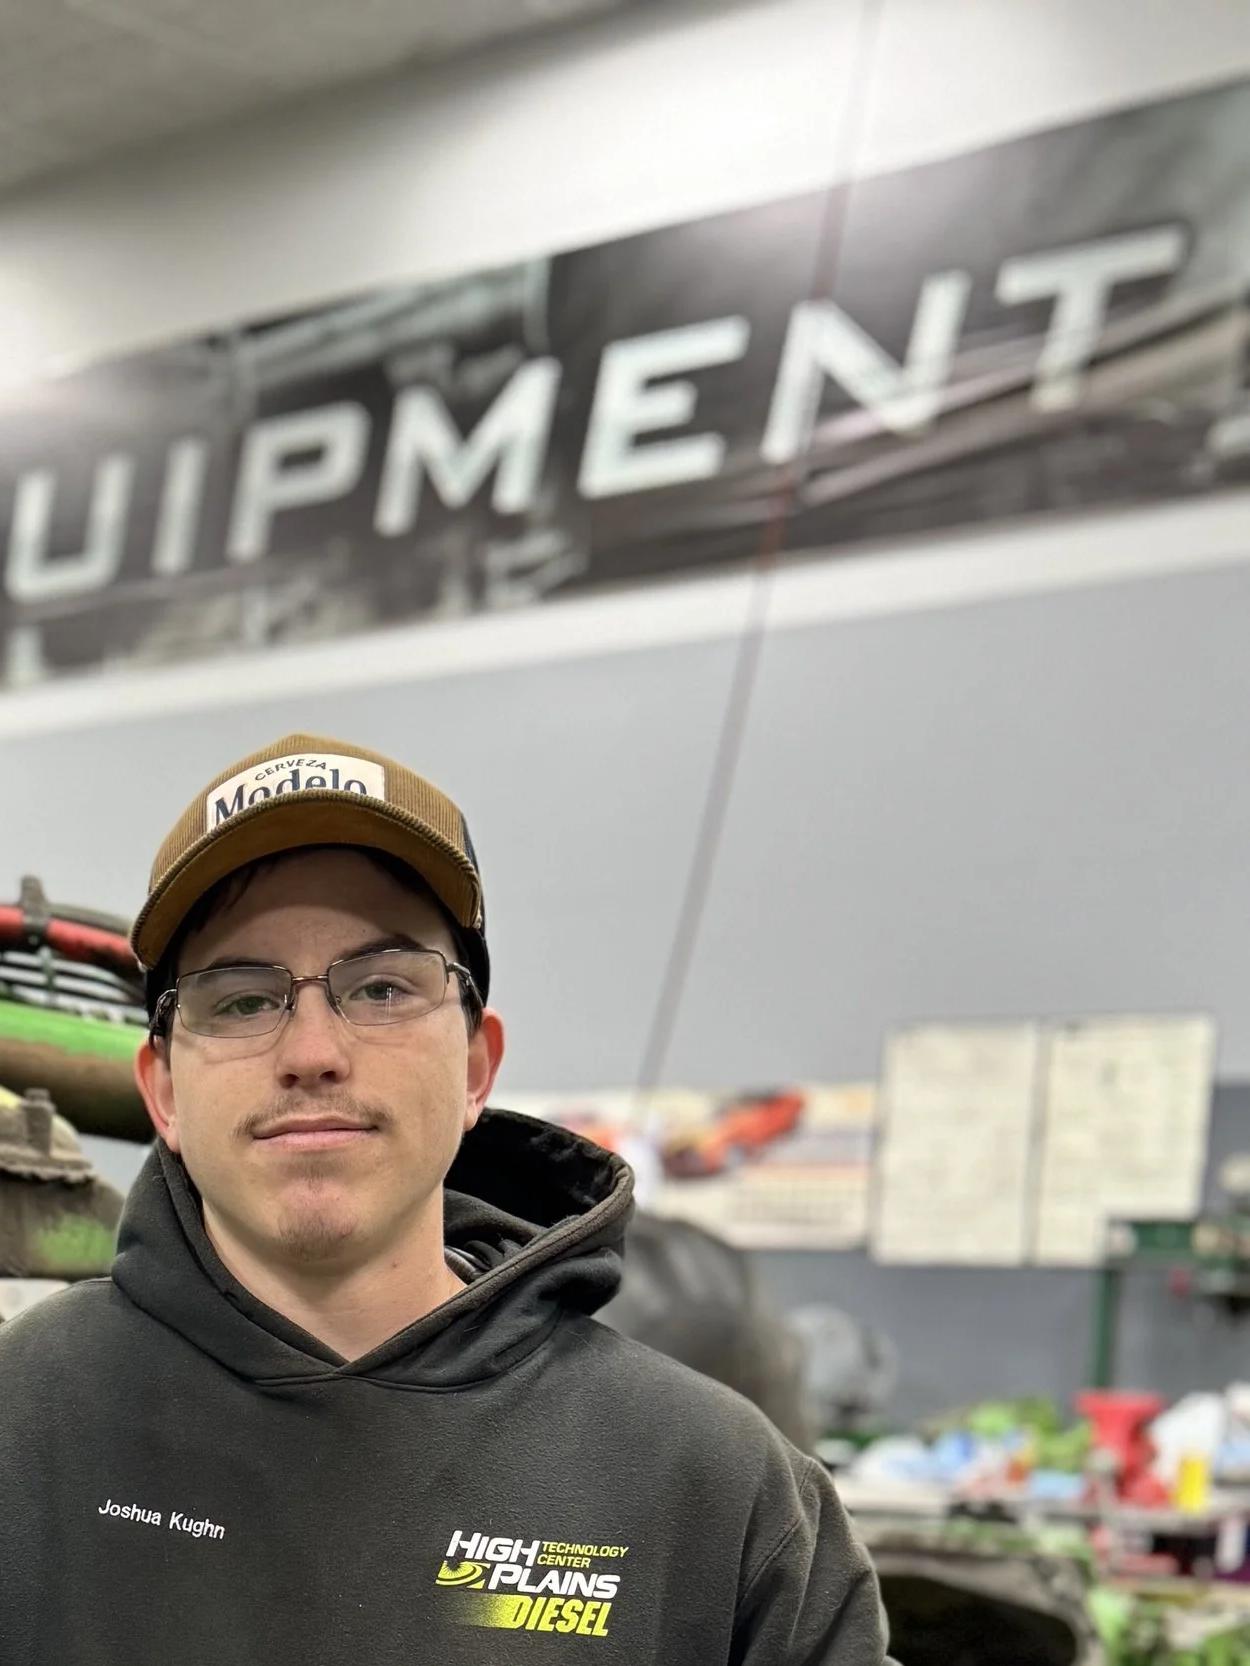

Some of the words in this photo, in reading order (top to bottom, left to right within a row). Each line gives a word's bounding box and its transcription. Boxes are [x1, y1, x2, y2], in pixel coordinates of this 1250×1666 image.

[255, 758, 327, 781] CERVEZA
[215, 768, 368, 826] Modelo
[99, 1499, 162, 1526] Joshua
[169, 1511, 225, 1539] Kughn
[446, 1530, 540, 1567] HIGH
[537, 1554, 591, 1569] CENTER
[541, 1541, 629, 1558] TECHNOLOGY
[488, 1563, 621, 1599] PLAINS
[508, 1595, 612, 1637] DIESEL
